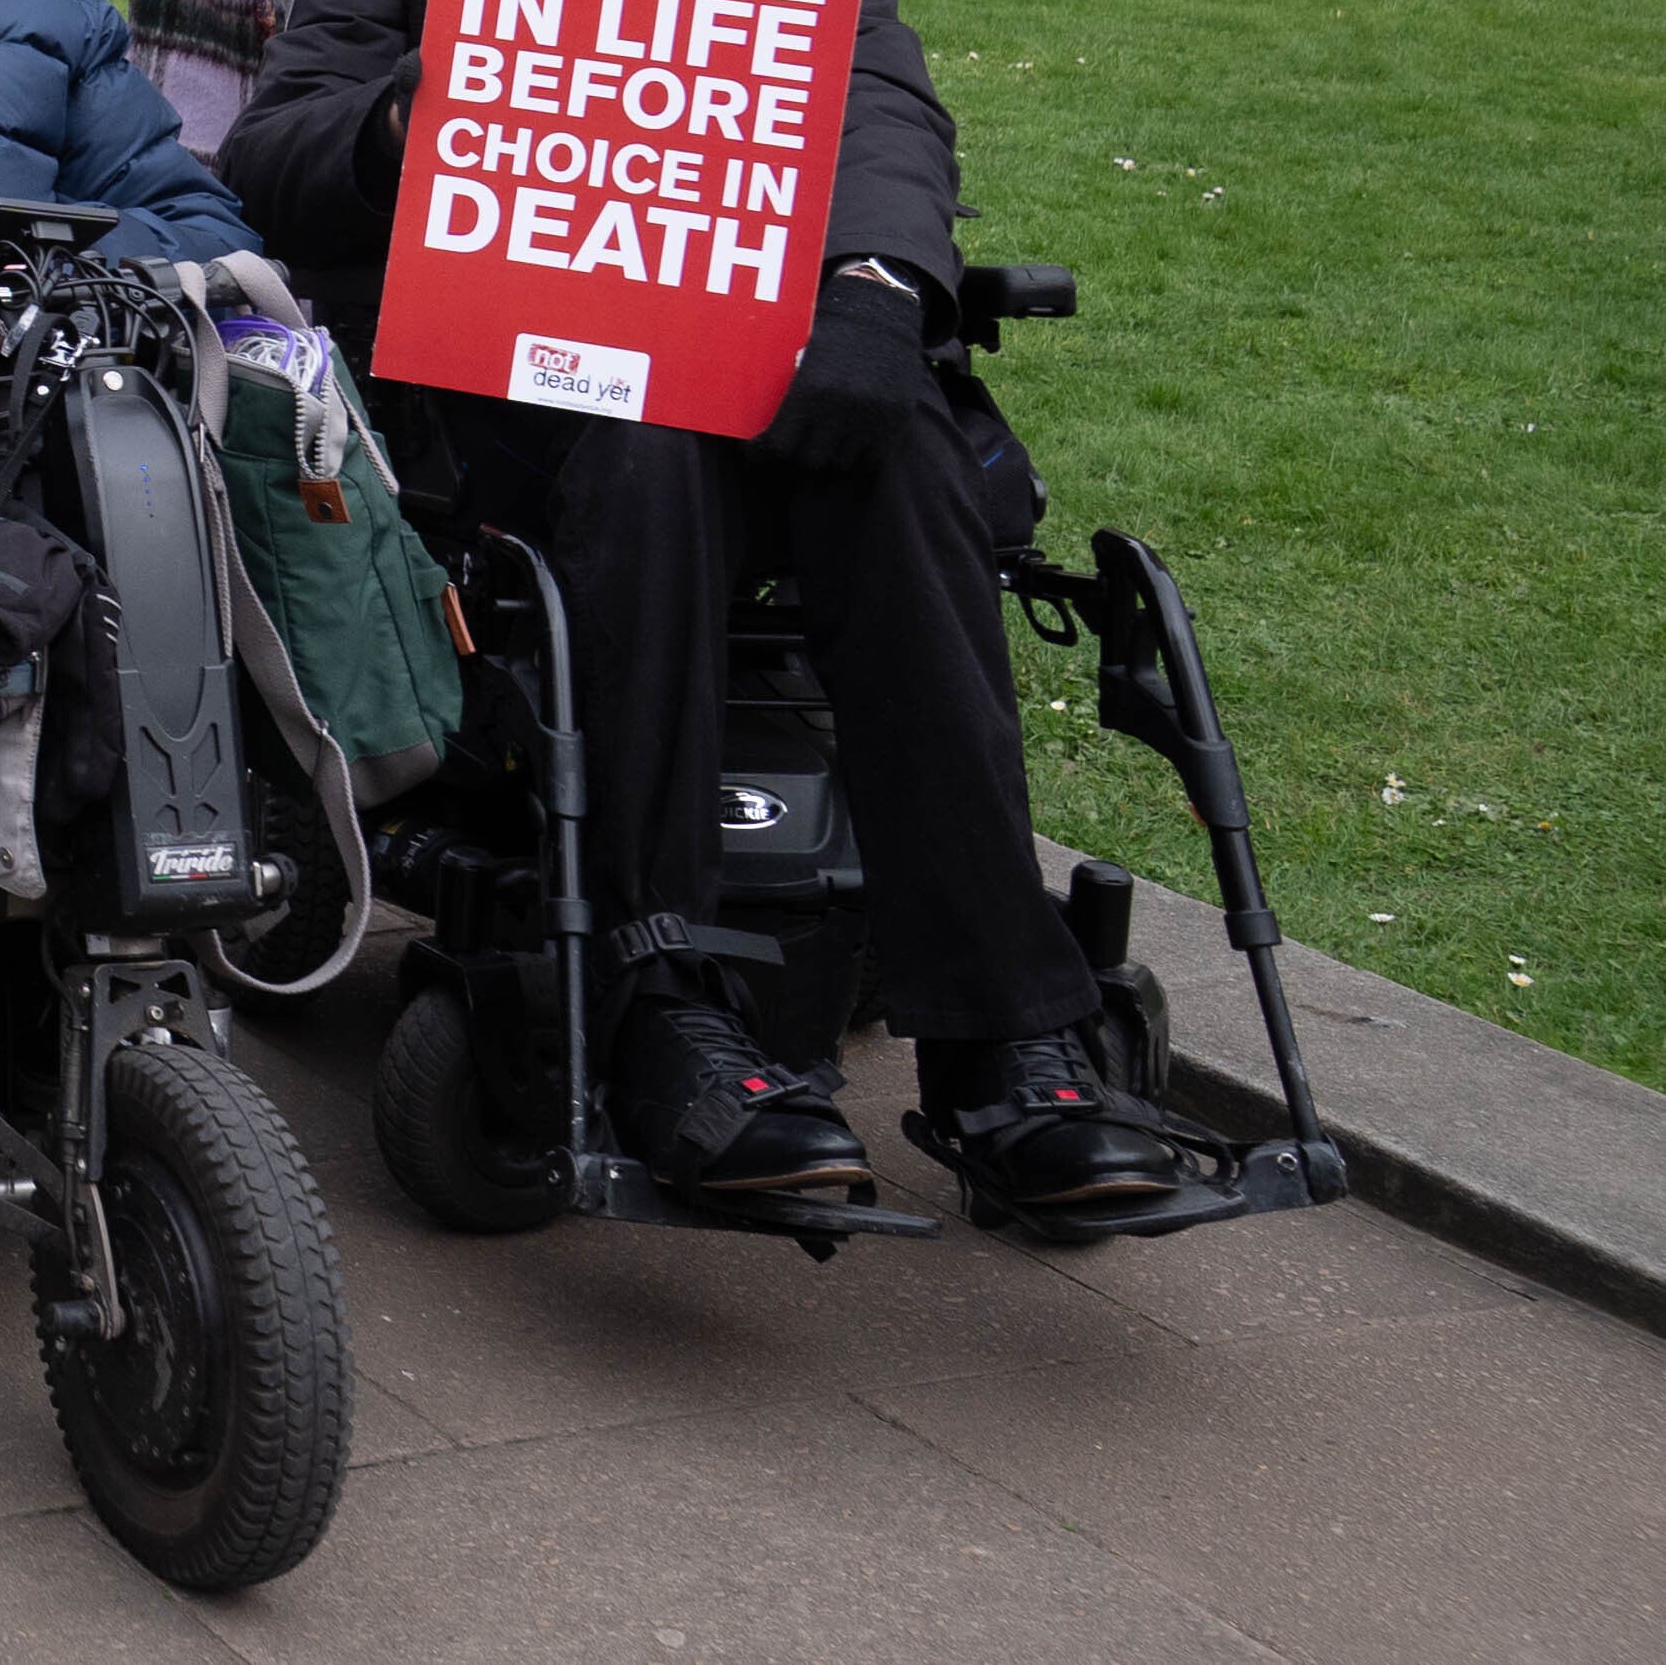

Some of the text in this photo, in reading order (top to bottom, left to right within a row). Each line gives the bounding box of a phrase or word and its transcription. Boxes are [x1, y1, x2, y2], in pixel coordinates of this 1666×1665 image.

[447, 41, 809, 150] BEFORE
[436, 117, 798, 217] CHOICE IN
[424, 173, 788, 303] DEATH
[532, 345, 578, 373] not
[533, 368, 632, 403] dead yet
